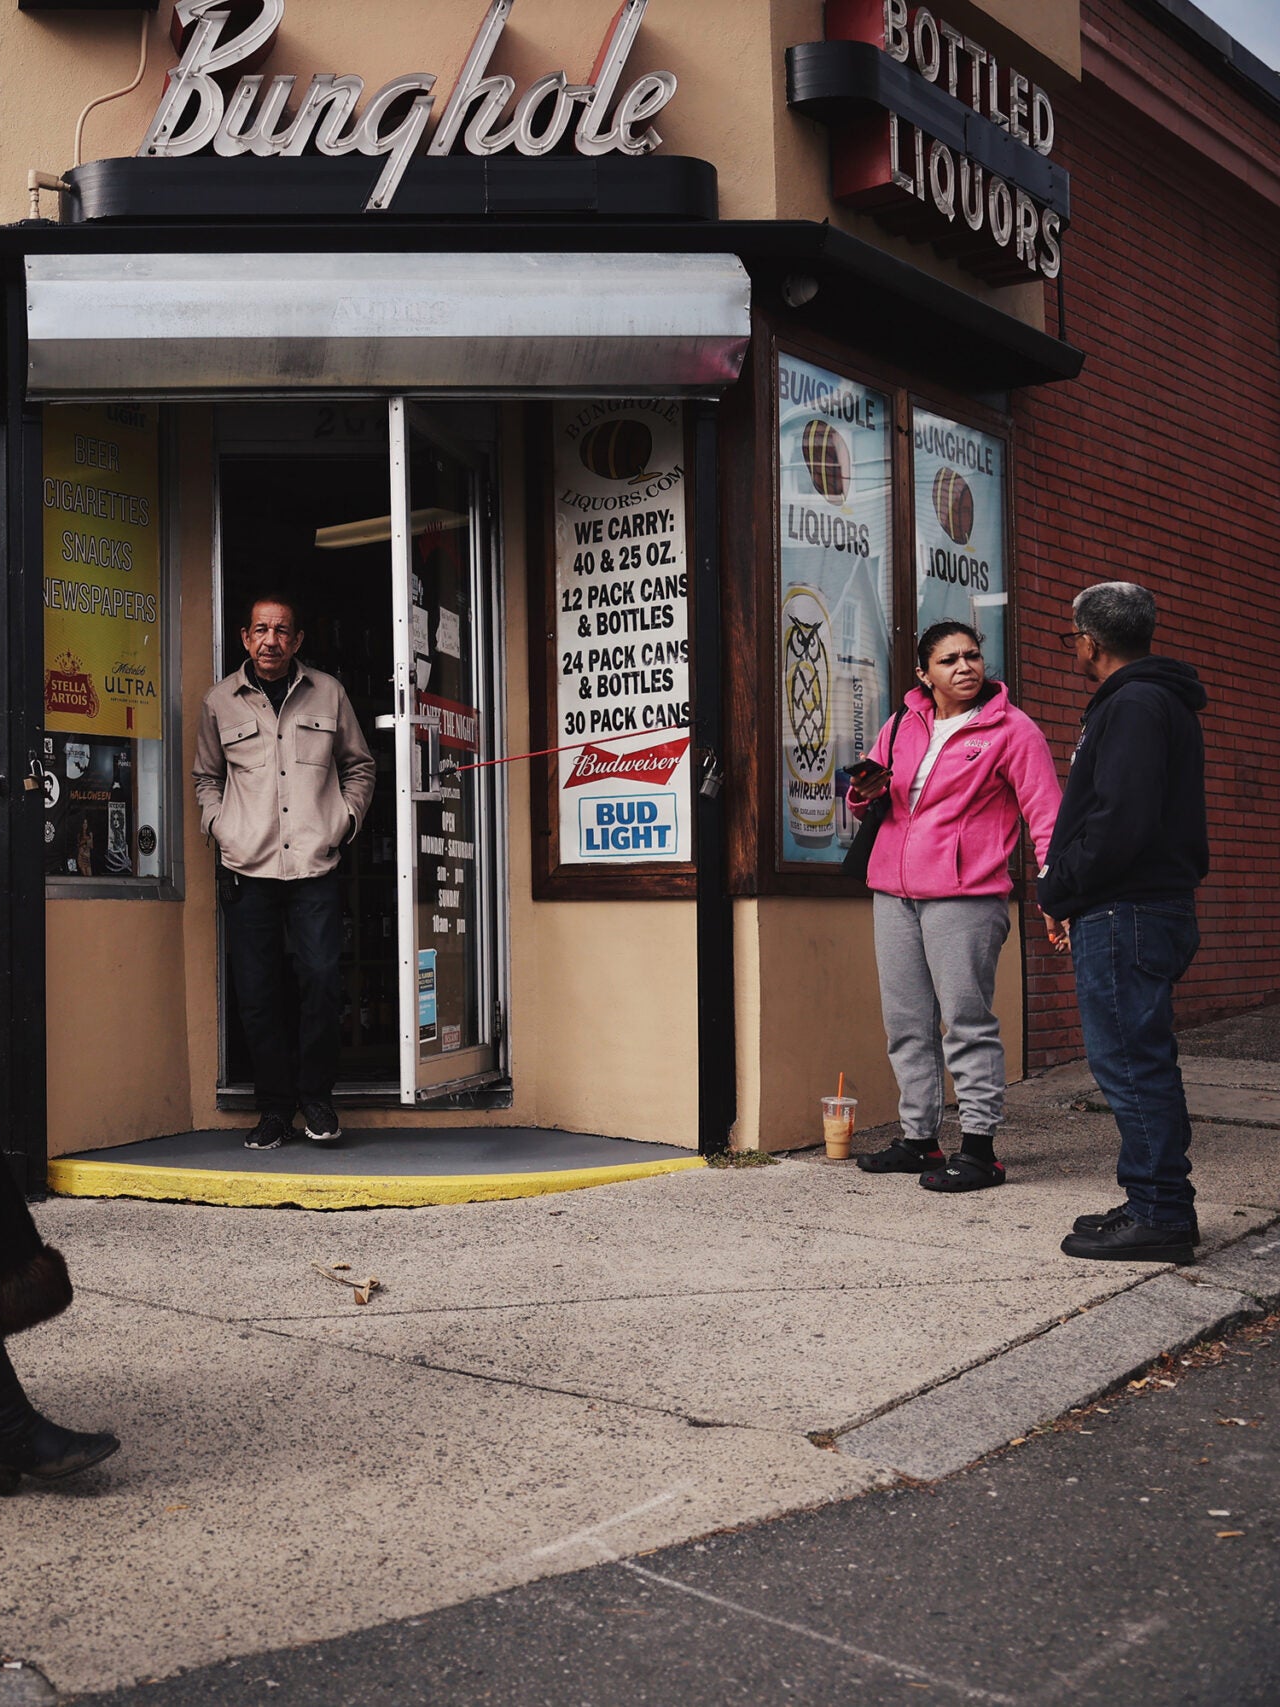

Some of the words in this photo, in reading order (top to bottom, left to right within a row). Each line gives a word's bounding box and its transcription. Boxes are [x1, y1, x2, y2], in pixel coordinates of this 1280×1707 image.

[884, 0, 1055, 156] BOTTLED
[137, 0, 677, 212] Bunghole
[889, 110, 1061, 279] LIQUORS
[779, 367, 876, 431] BUNGHOLE
[565, 397, 680, 440] BUNGHOLE
[75, 432, 120, 472] BEER
[914, 424, 994, 476] BUNGHOLE
[43, 476, 150, 527] CIGARETTES
[561, 464, 687, 512] LIQUORS.COM
[574, 520, 603, 545] WE
[607, 508, 674, 540] CARRY:
[788, 504, 869, 558] LIQUORS
[62, 530, 133, 571] SNACKS
[573, 551, 595, 576] 40
[600, 549, 615, 573] &
[619, 545, 641, 570] 25
[646, 540, 676, 566] OZ.
[920, 544, 989, 592] LIQUORS
[43, 577, 157, 623] NEWSPAPERS
[562, 587, 582, 612] 12
[588, 581, 635, 609] PACK
[640, 573, 688, 602] CANS
[577, 614, 592, 638] &
[596, 604, 674, 636] BOTTLES
[562, 650, 583, 675] 24
[588, 645, 636, 673] PACK
[641, 639, 689, 666] CANS
[51, 680, 88, 693] STELLA
[51, 692, 88, 706] ARTOIS
[105, 676, 157, 697] ULTRA
[579, 675, 592, 699] &
[597, 667, 674, 698] BOTTLES
[442, 709, 456, 738] THE
[455, 713, 475, 742] NIGHT
[565, 711, 586, 735] 30
[590, 706, 637, 733] PACK
[642, 701, 690, 728] CANS
[853, 675, 864, 750] DOWNEAST
[573, 753, 680, 777] Budweiser
[70, 790, 111, 800] HALLOWEEN
[442, 811, 456, 832] OPEN
[596, 801, 657, 826] BUD
[421, 834, 445, 855] MONDAY
[448, 839, 474, 859] SATURDAY
[585, 825, 672, 850] LIGHT
[438, 889, 460, 908] SUNDAY
